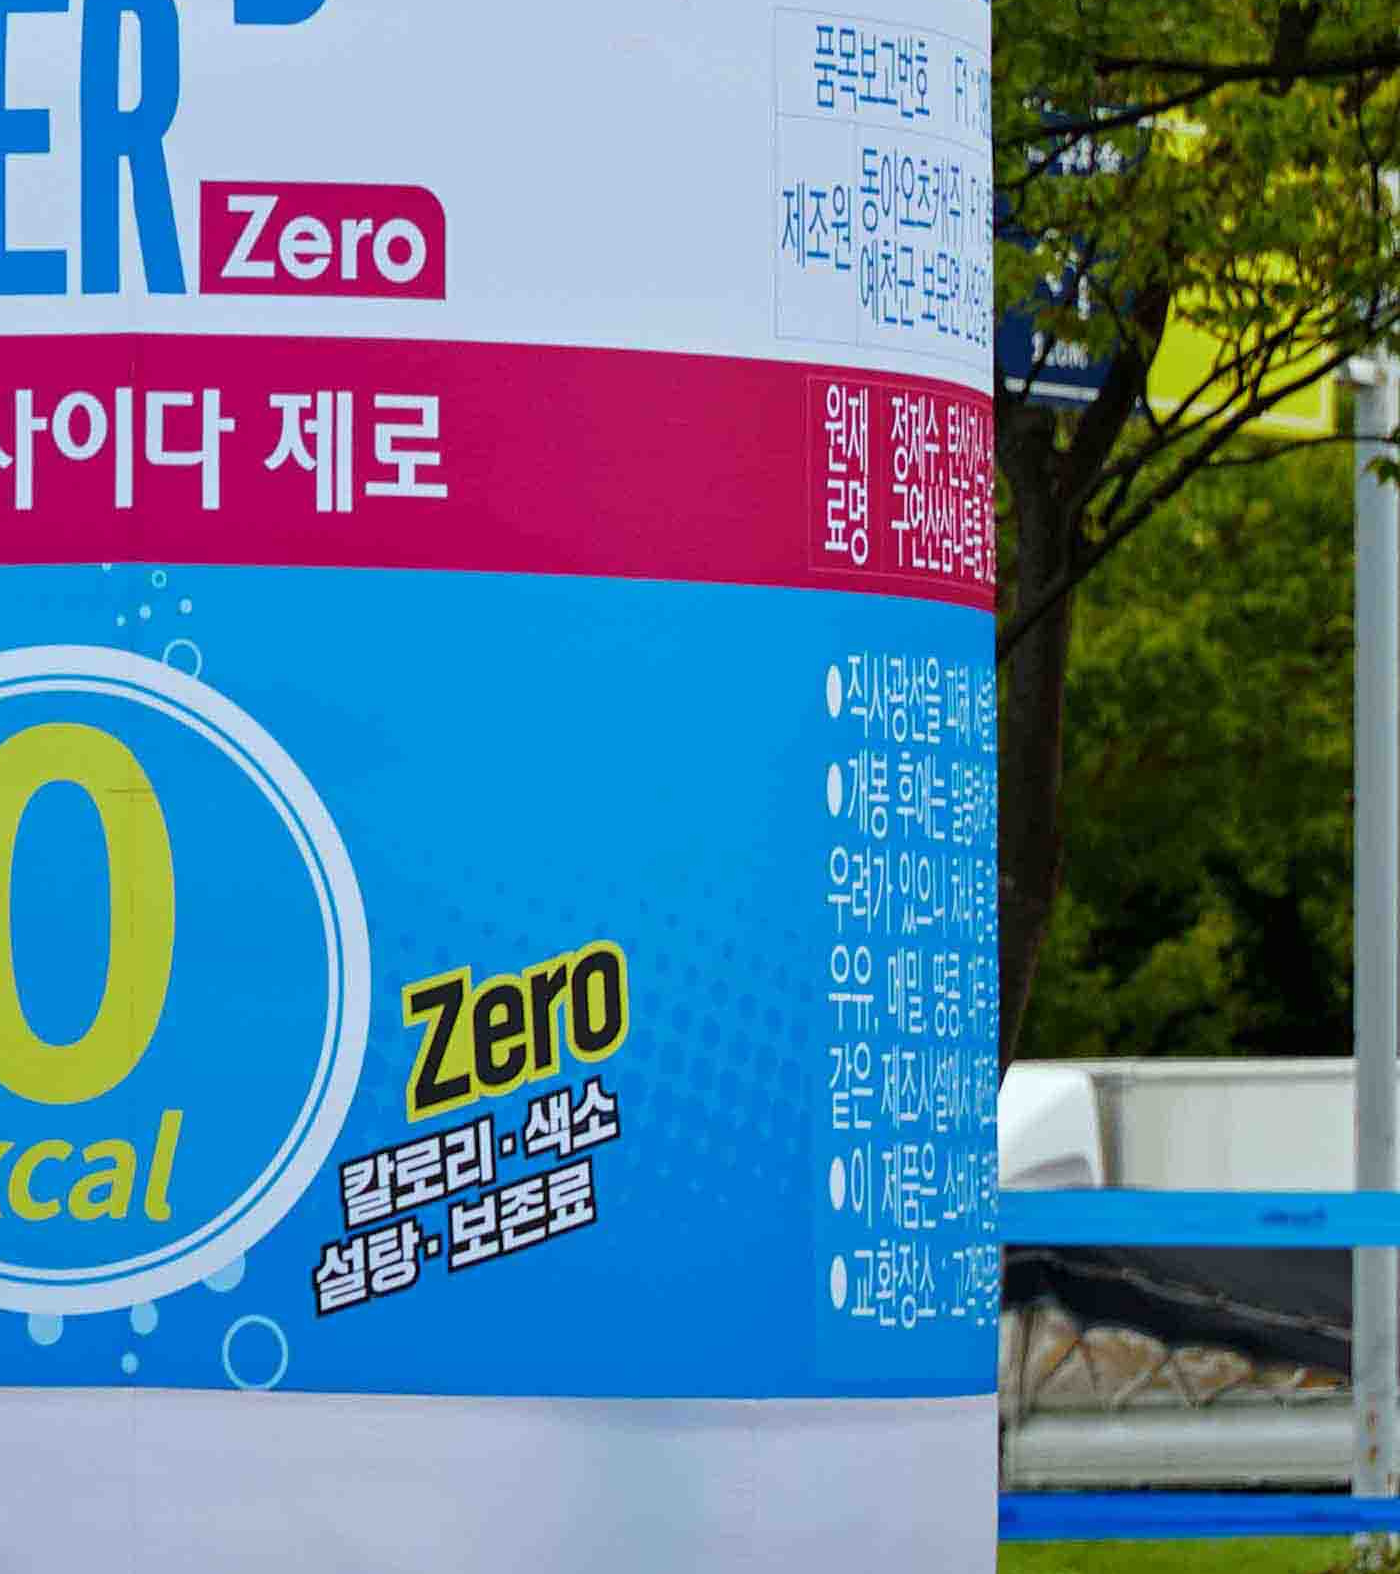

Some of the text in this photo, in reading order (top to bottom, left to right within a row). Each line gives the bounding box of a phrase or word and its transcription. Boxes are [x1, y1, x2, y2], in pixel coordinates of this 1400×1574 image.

[814, 25, 930, 118] 품목보고번호
[220, 195, 426, 280] Zero
[782, 179, 851, 270] 제조원
[264, 390, 447, 512] 제로
[406, 945, 625, 1117] Zero
